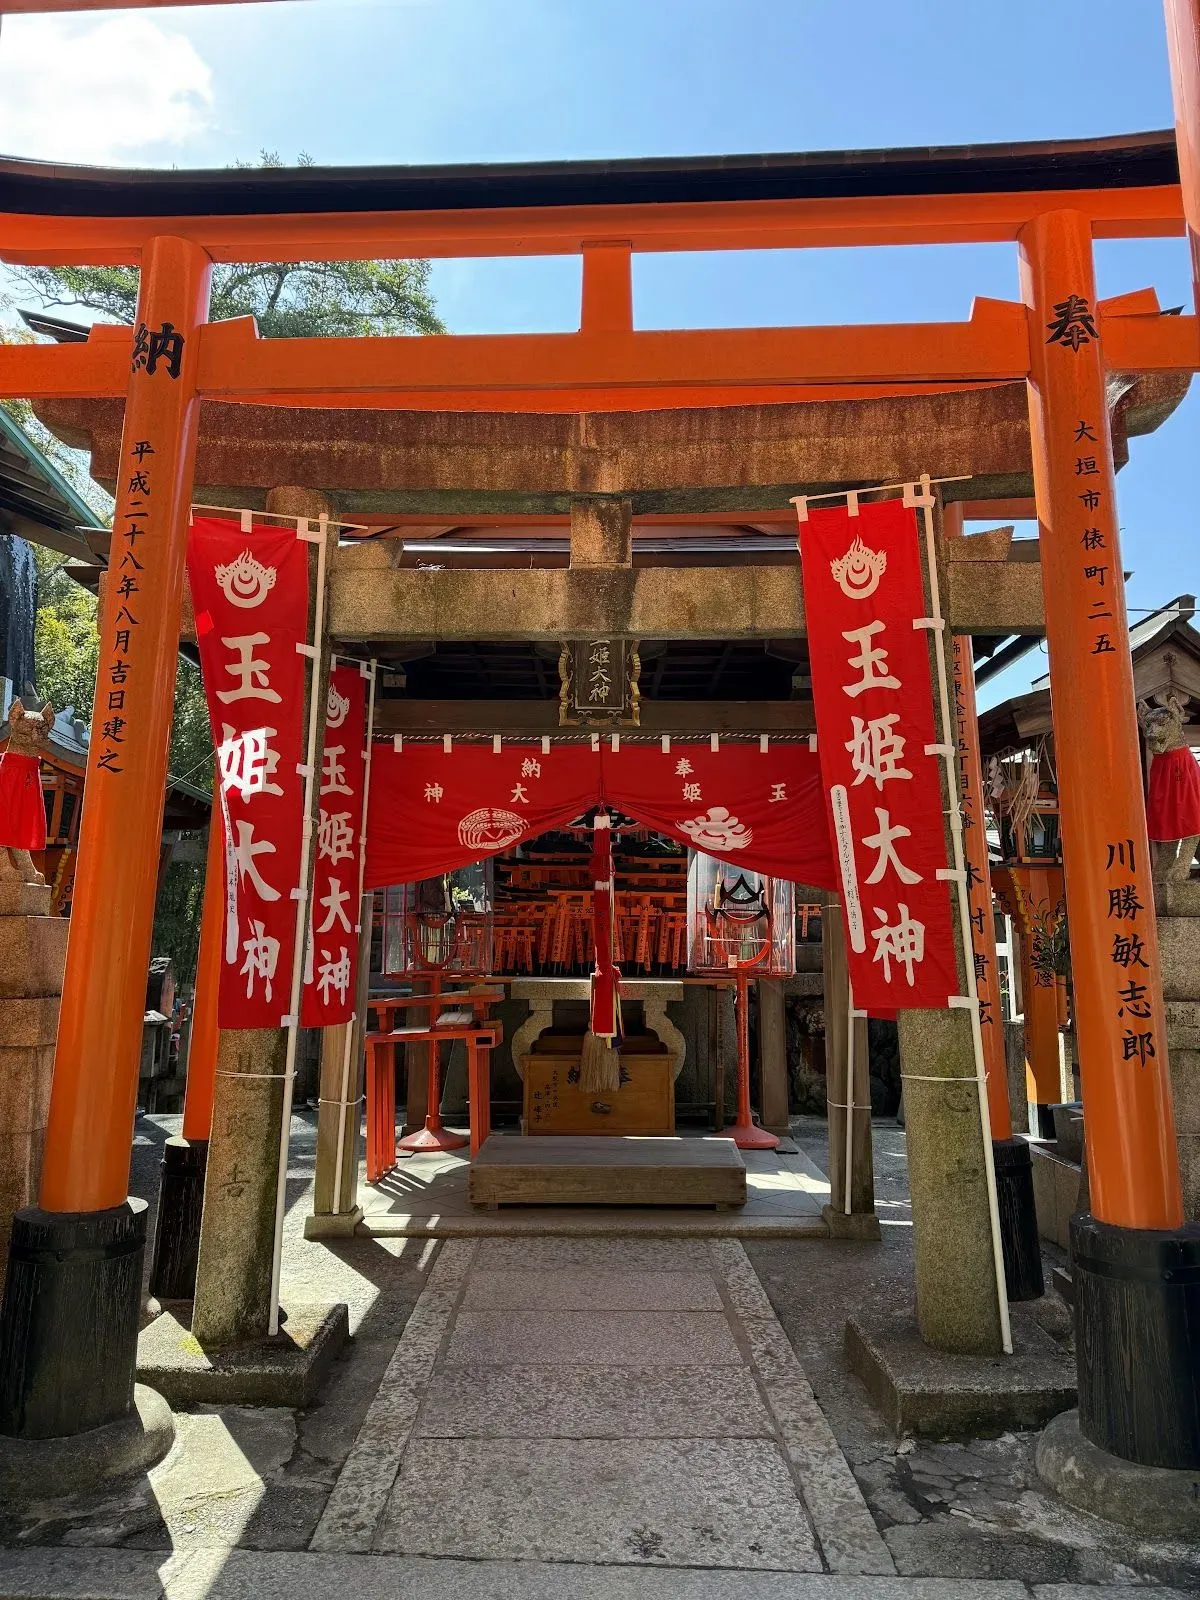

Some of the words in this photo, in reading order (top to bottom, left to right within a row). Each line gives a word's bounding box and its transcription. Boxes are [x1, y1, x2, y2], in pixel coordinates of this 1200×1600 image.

[131, 322, 185, 380] 納
[1045, 294, 1099, 353] 奉
[96, 440, 156, 773] 平成二十八年八月吉日建之
[1073, 420, 1116, 655] 大垣市俵町二五
[588, 640, 612, 704] 姫大神
[215, 631, 285, 1003] 玉姫大神
[316, 744, 356, 1006] 玉姫大神
[841, 619, 926, 987] 玉姫大神
[1106, 840, 1156, 1068] 川勝敏志郎
